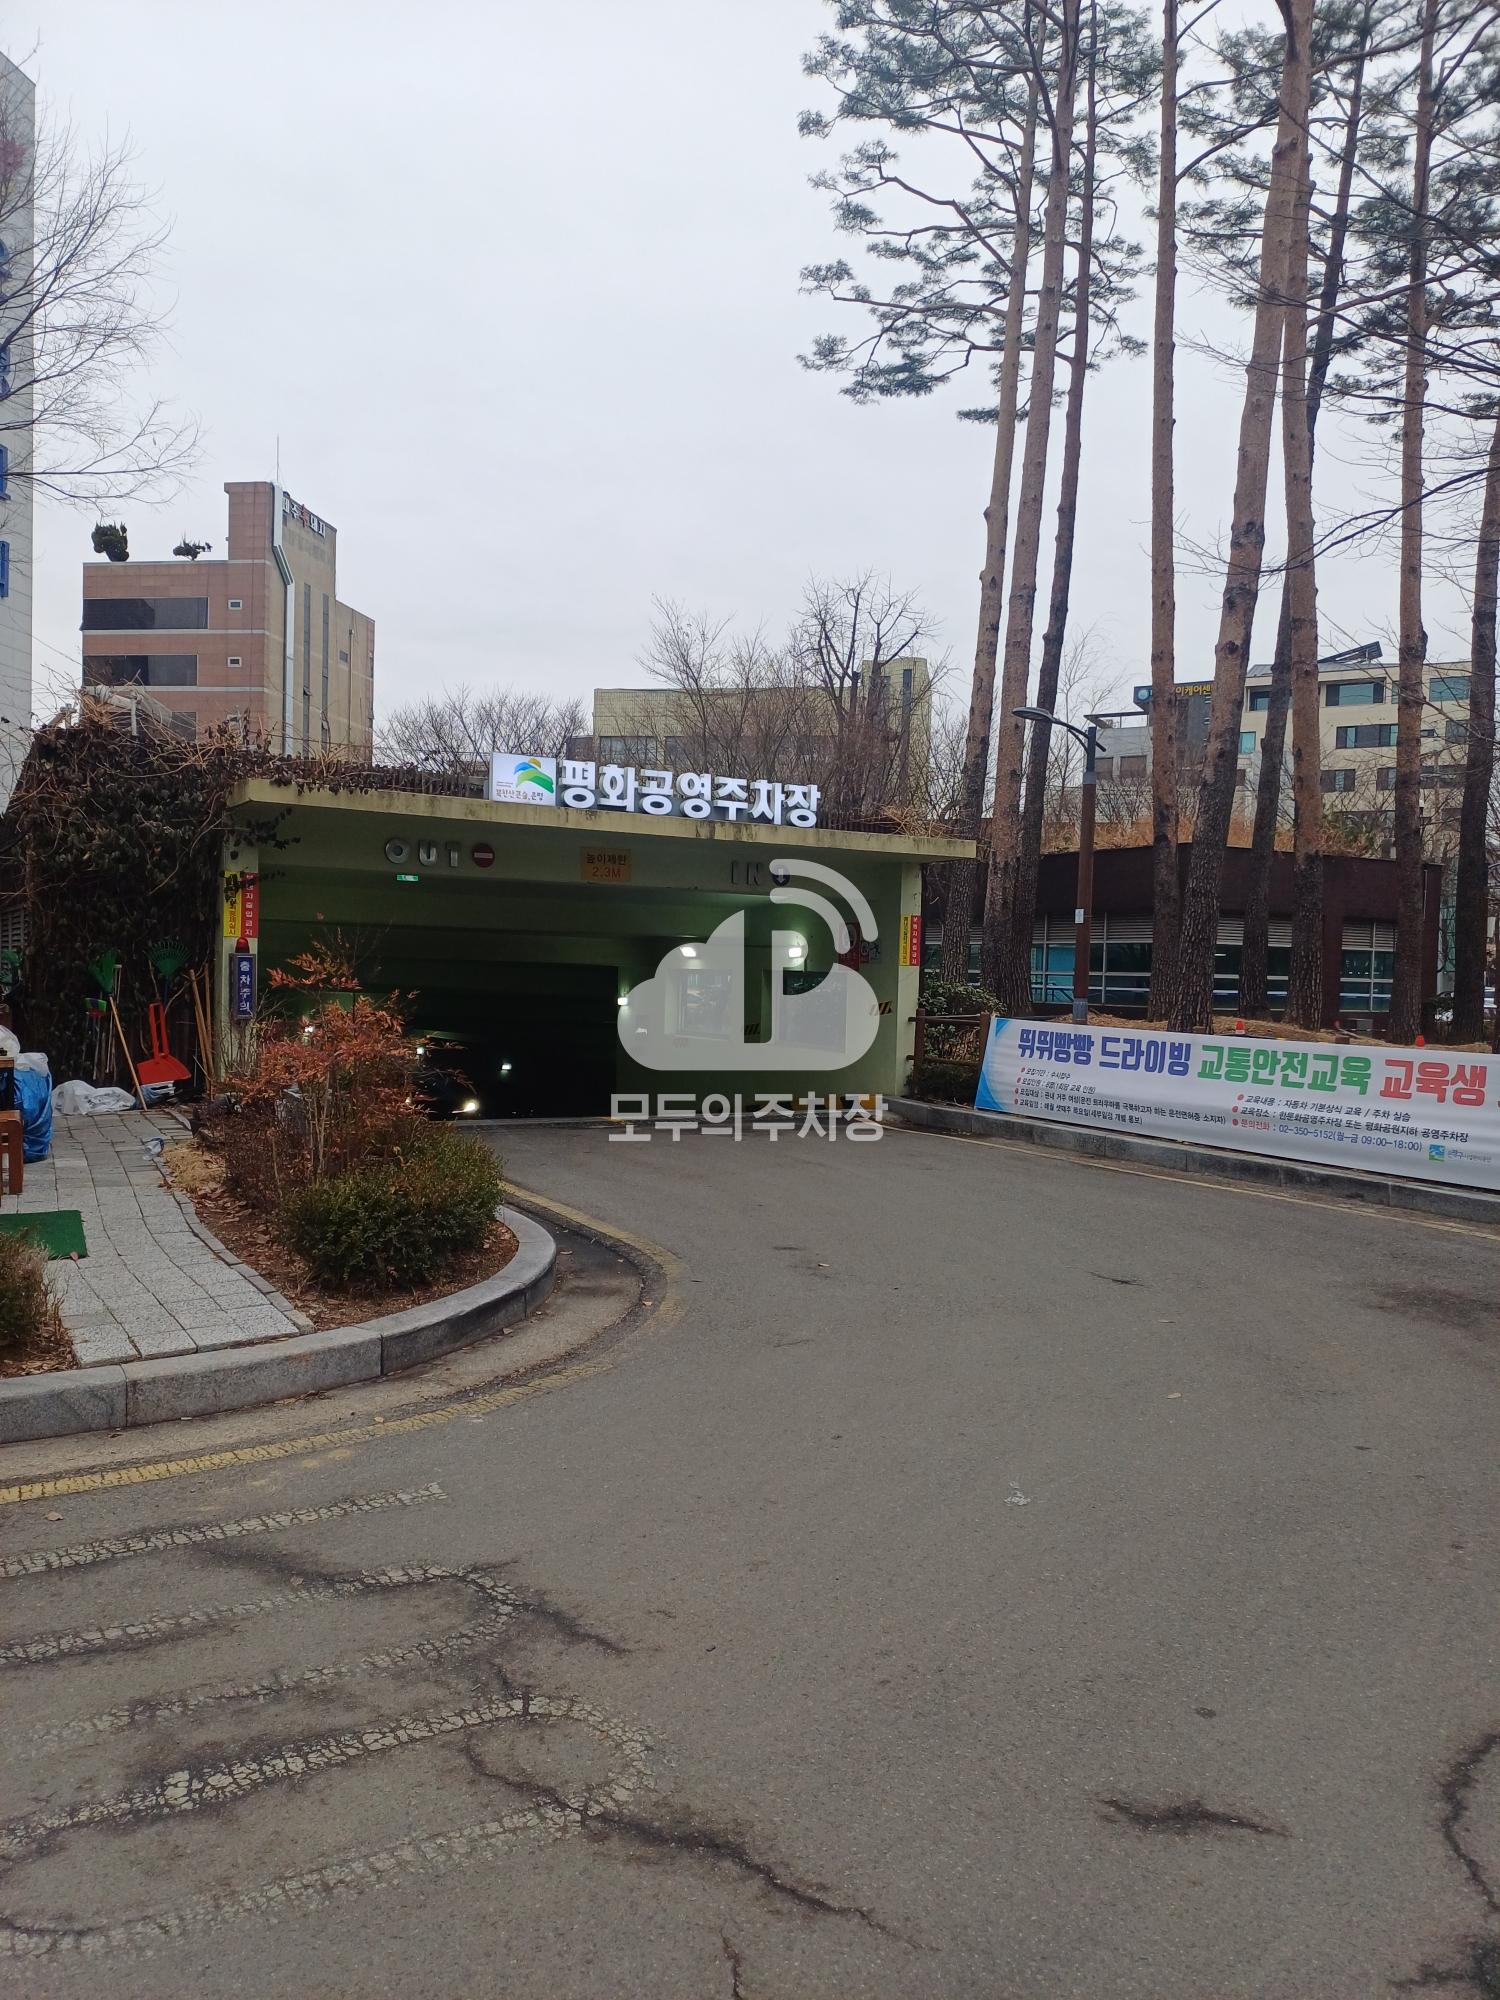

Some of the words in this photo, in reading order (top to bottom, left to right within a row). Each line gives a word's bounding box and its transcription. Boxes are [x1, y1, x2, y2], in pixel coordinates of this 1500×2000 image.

[561, 759, 821, 828] 평화공영주차장
[384, 837, 462, 868] OUT
[591, 866, 622, 879] 2.3M
[1098, 1035, 1192, 1077] 드라이빙
[1197, 1044, 1373, 1096] 교통안전교육
[1380, 1058, 1488, 1107] 교육생
[1245, 1095, 1276, 1107] 교육내용
[1283, 1099, 1308, 1110] 자동차
[1344, 1106, 1362, 1116] 교육
[1372, 1109, 1390, 1120] 주차
[1392, 1111, 1411, 1123] 실습
[1420, 1128, 1469, 1143] 공영주차장
